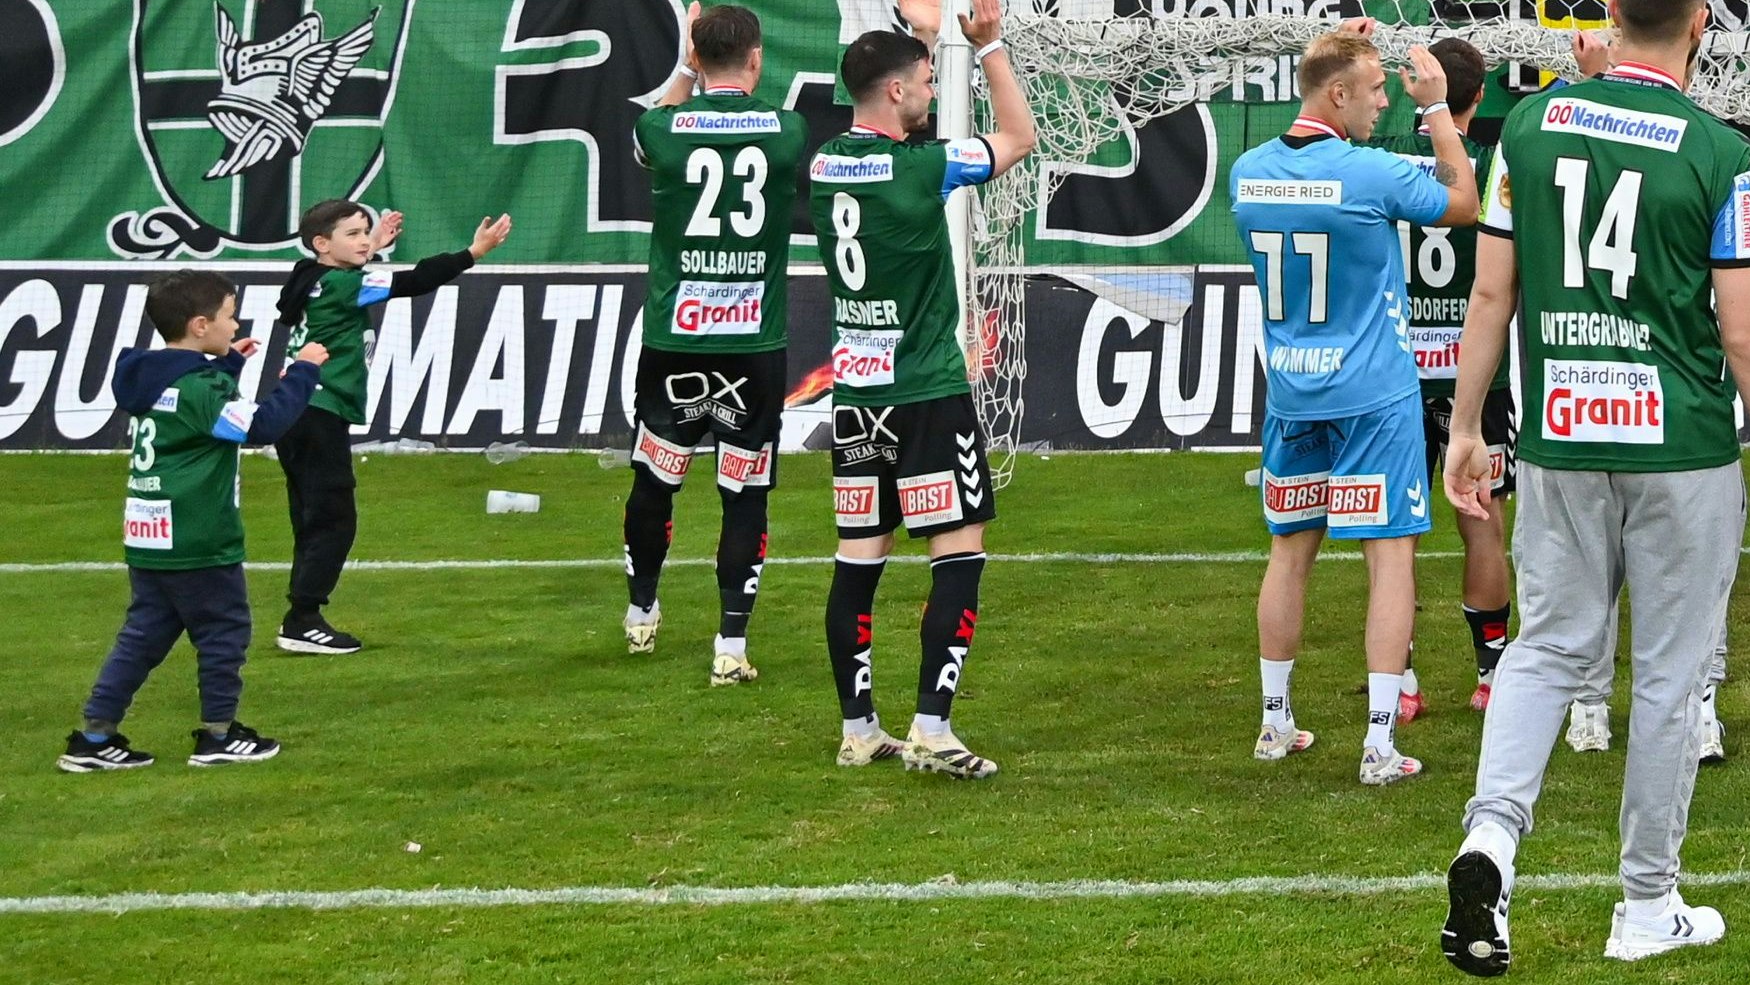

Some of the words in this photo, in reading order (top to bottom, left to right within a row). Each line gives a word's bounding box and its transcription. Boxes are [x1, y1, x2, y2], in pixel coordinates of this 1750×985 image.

[675, 111, 778, 130] OÖNachrichten
[1547, 100, 1679, 144] OÖNachrichten
[684, 146, 768, 237] 23
[1241, 184, 1296, 198] ENERGIE
[1300, 184, 1334, 198] RIED
[832, 192, 866, 292] 8
[1554, 157, 1643, 300] 14
[681, 250, 766, 274] SOLLBAUER
[684, 283, 761, 299] Schärdinger
[1249, 230, 1329, 324] 11
[676, 299, 759, 331] Granit
[1407, 297, 1468, 322] SDORFER
[1270, 345, 1344, 374] WIMMER
[1414, 342, 1461, 368] anit
[665, 371, 748, 410] OX
[1551, 365, 1654, 390] Schärdinger
[833, 405, 898, 443] OX
[1546, 387, 1659, 436] Granit
[833, 488, 871, 514] BAST
[1329, 486, 1379, 513] BAST
